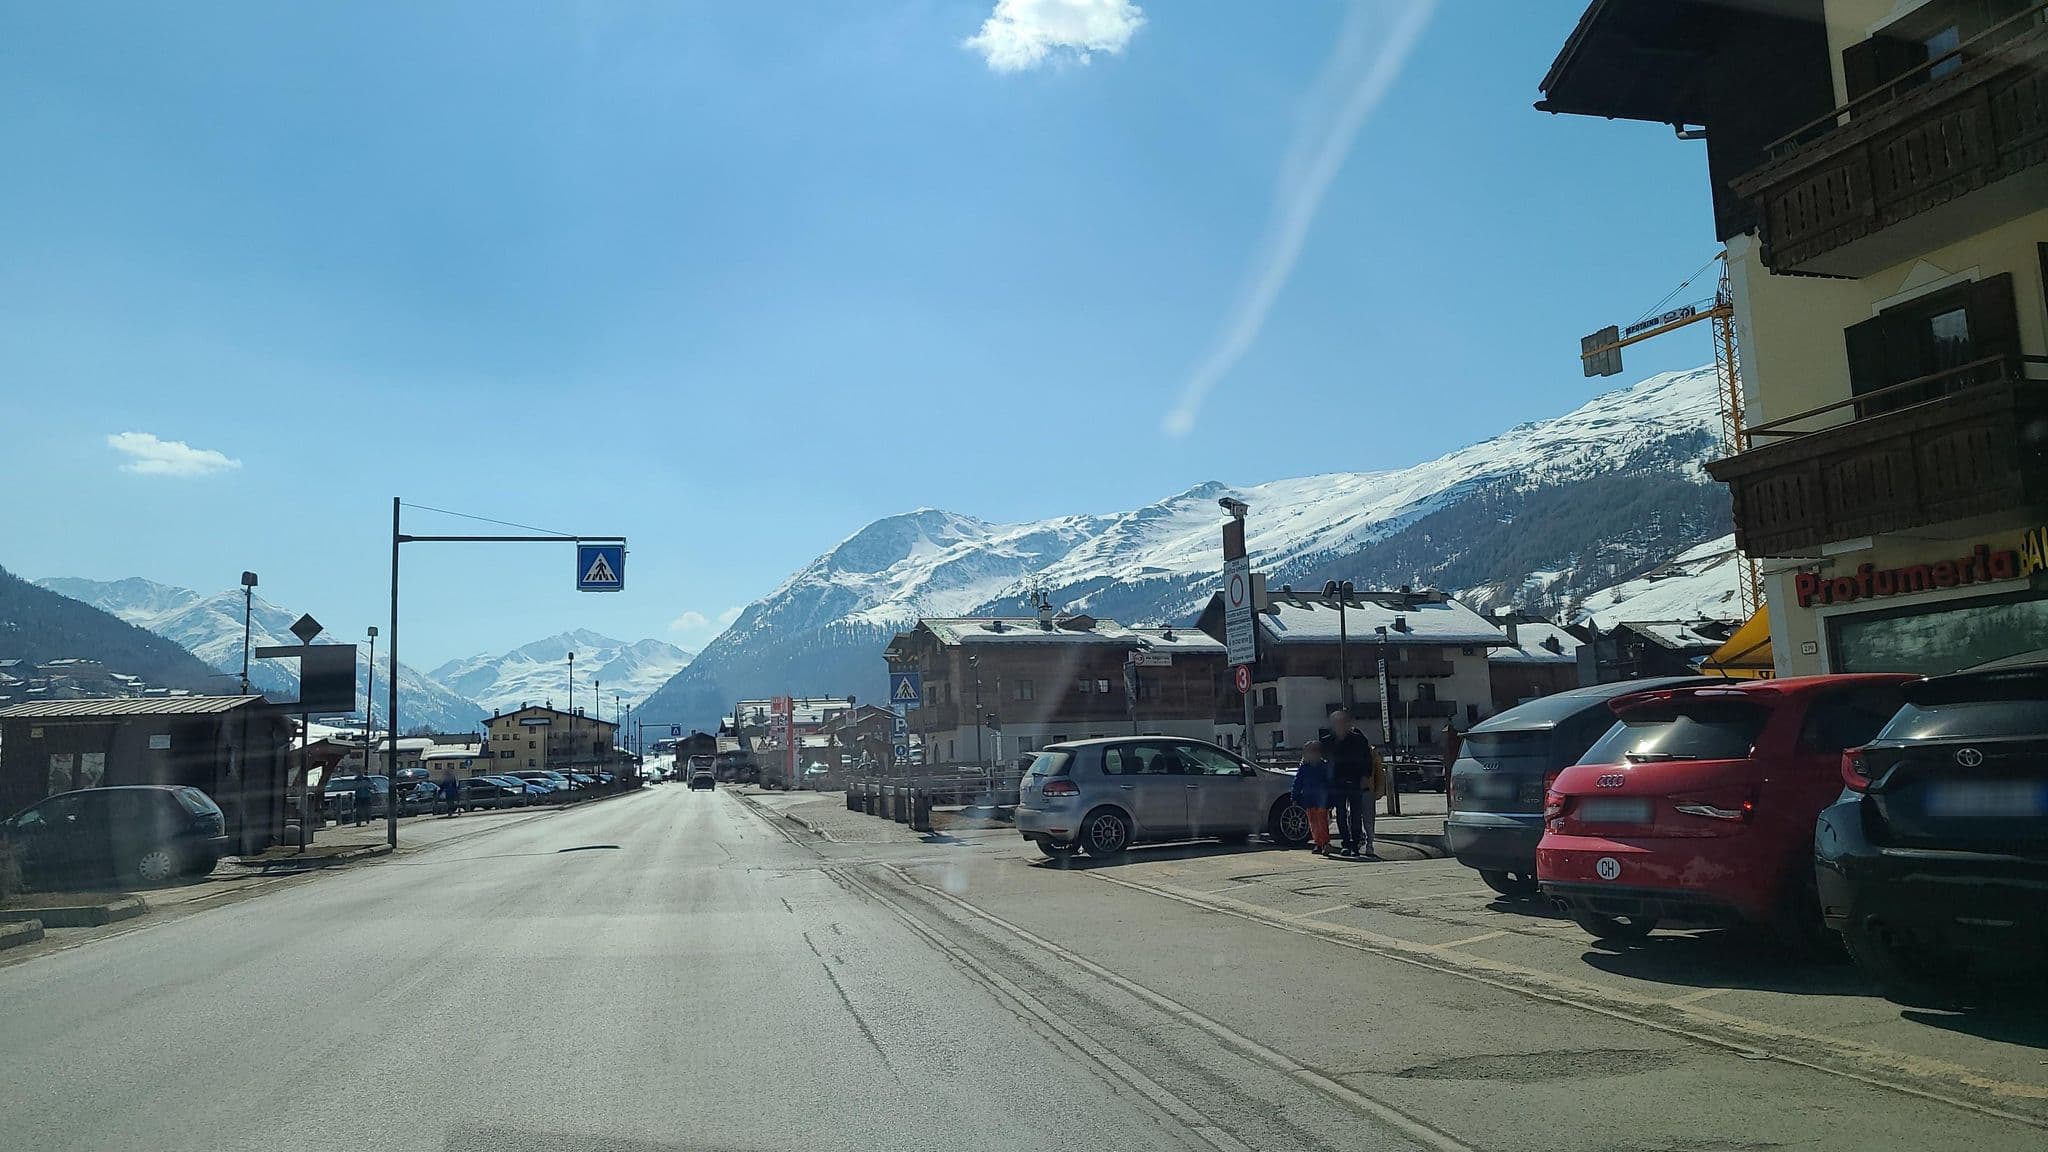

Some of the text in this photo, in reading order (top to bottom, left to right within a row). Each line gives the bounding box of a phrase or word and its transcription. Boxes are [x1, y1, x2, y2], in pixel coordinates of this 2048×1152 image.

[1795, 543, 2018, 607] Profumeria
[1238, 667, 1248, 690] 3
[896, 718, 907, 732] P
[1601, 861, 1614, 878] CH
